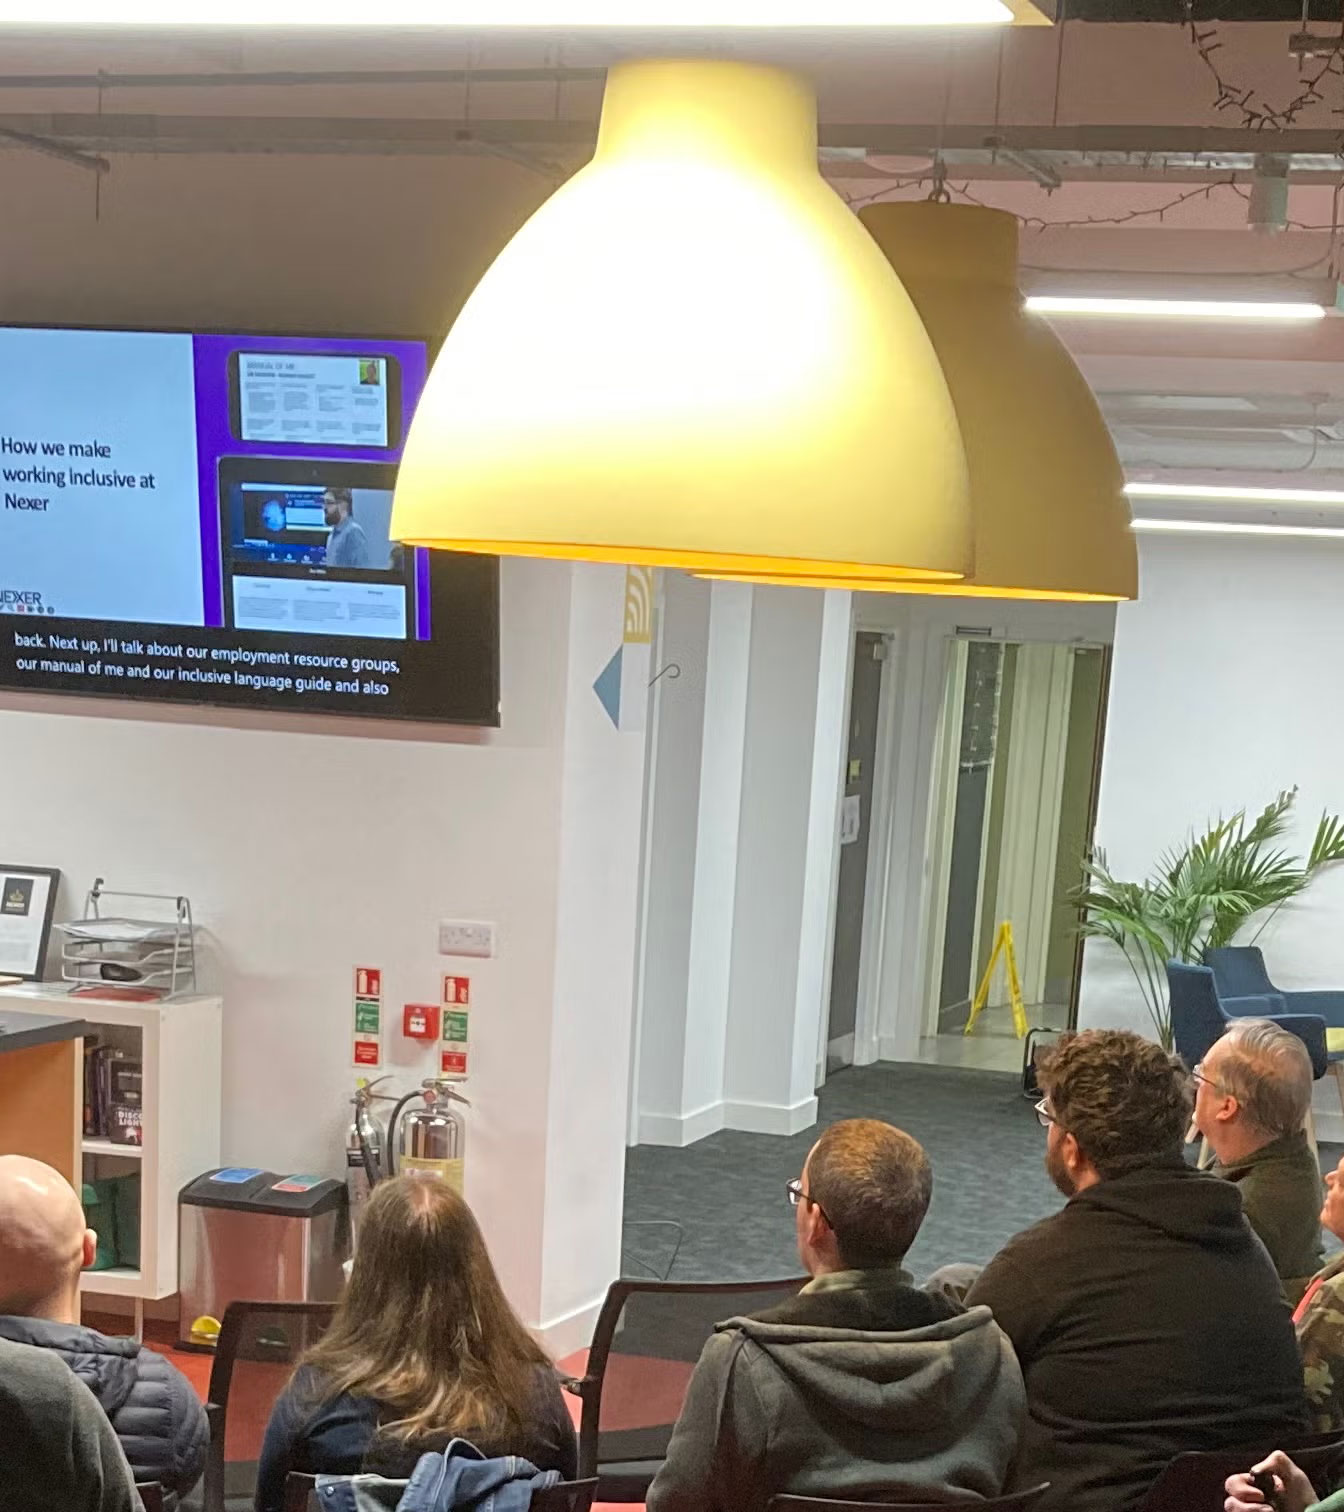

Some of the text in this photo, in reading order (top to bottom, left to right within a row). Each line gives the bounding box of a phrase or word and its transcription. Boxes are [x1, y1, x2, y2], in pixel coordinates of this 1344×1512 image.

[1, 436, 111, 458] How we make
[2, 465, 66, 488] working
[140, 472, 156, 489] at
[5, 493, 50, 511] Nexer
[14, 631, 400, 675] back. Next up, I'll talk about our employment resource groups,
[16, 658, 389, 696] our manual of me and our inclusive language guide and also
